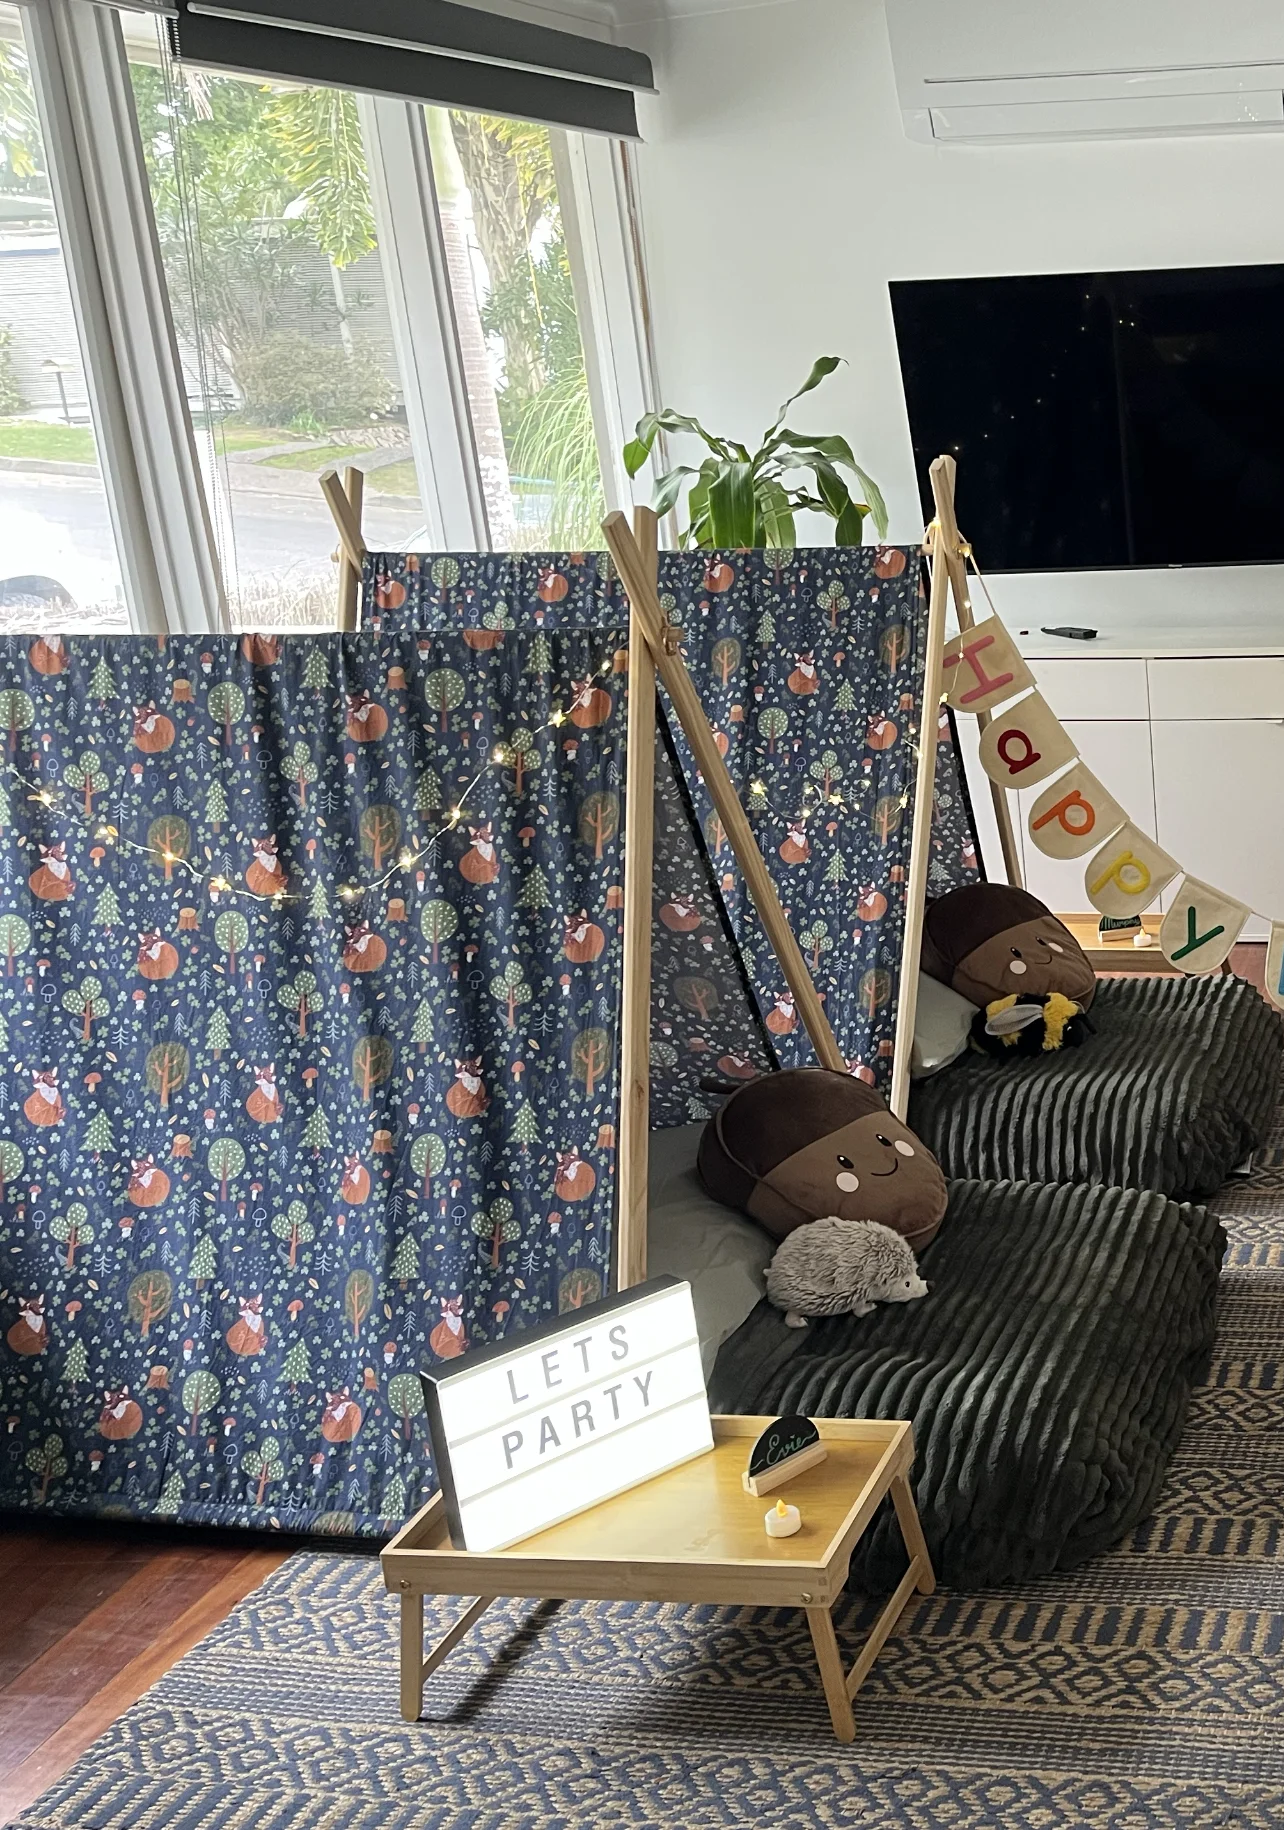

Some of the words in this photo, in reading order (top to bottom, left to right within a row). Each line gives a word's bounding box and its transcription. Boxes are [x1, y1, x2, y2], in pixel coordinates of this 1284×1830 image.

[943, 635, 1226, 962] Happy
[506, 1324, 630, 1404] LETS
[501, 1370, 654, 1469] PARTY
[766, 1431, 816, 1465] Evie
